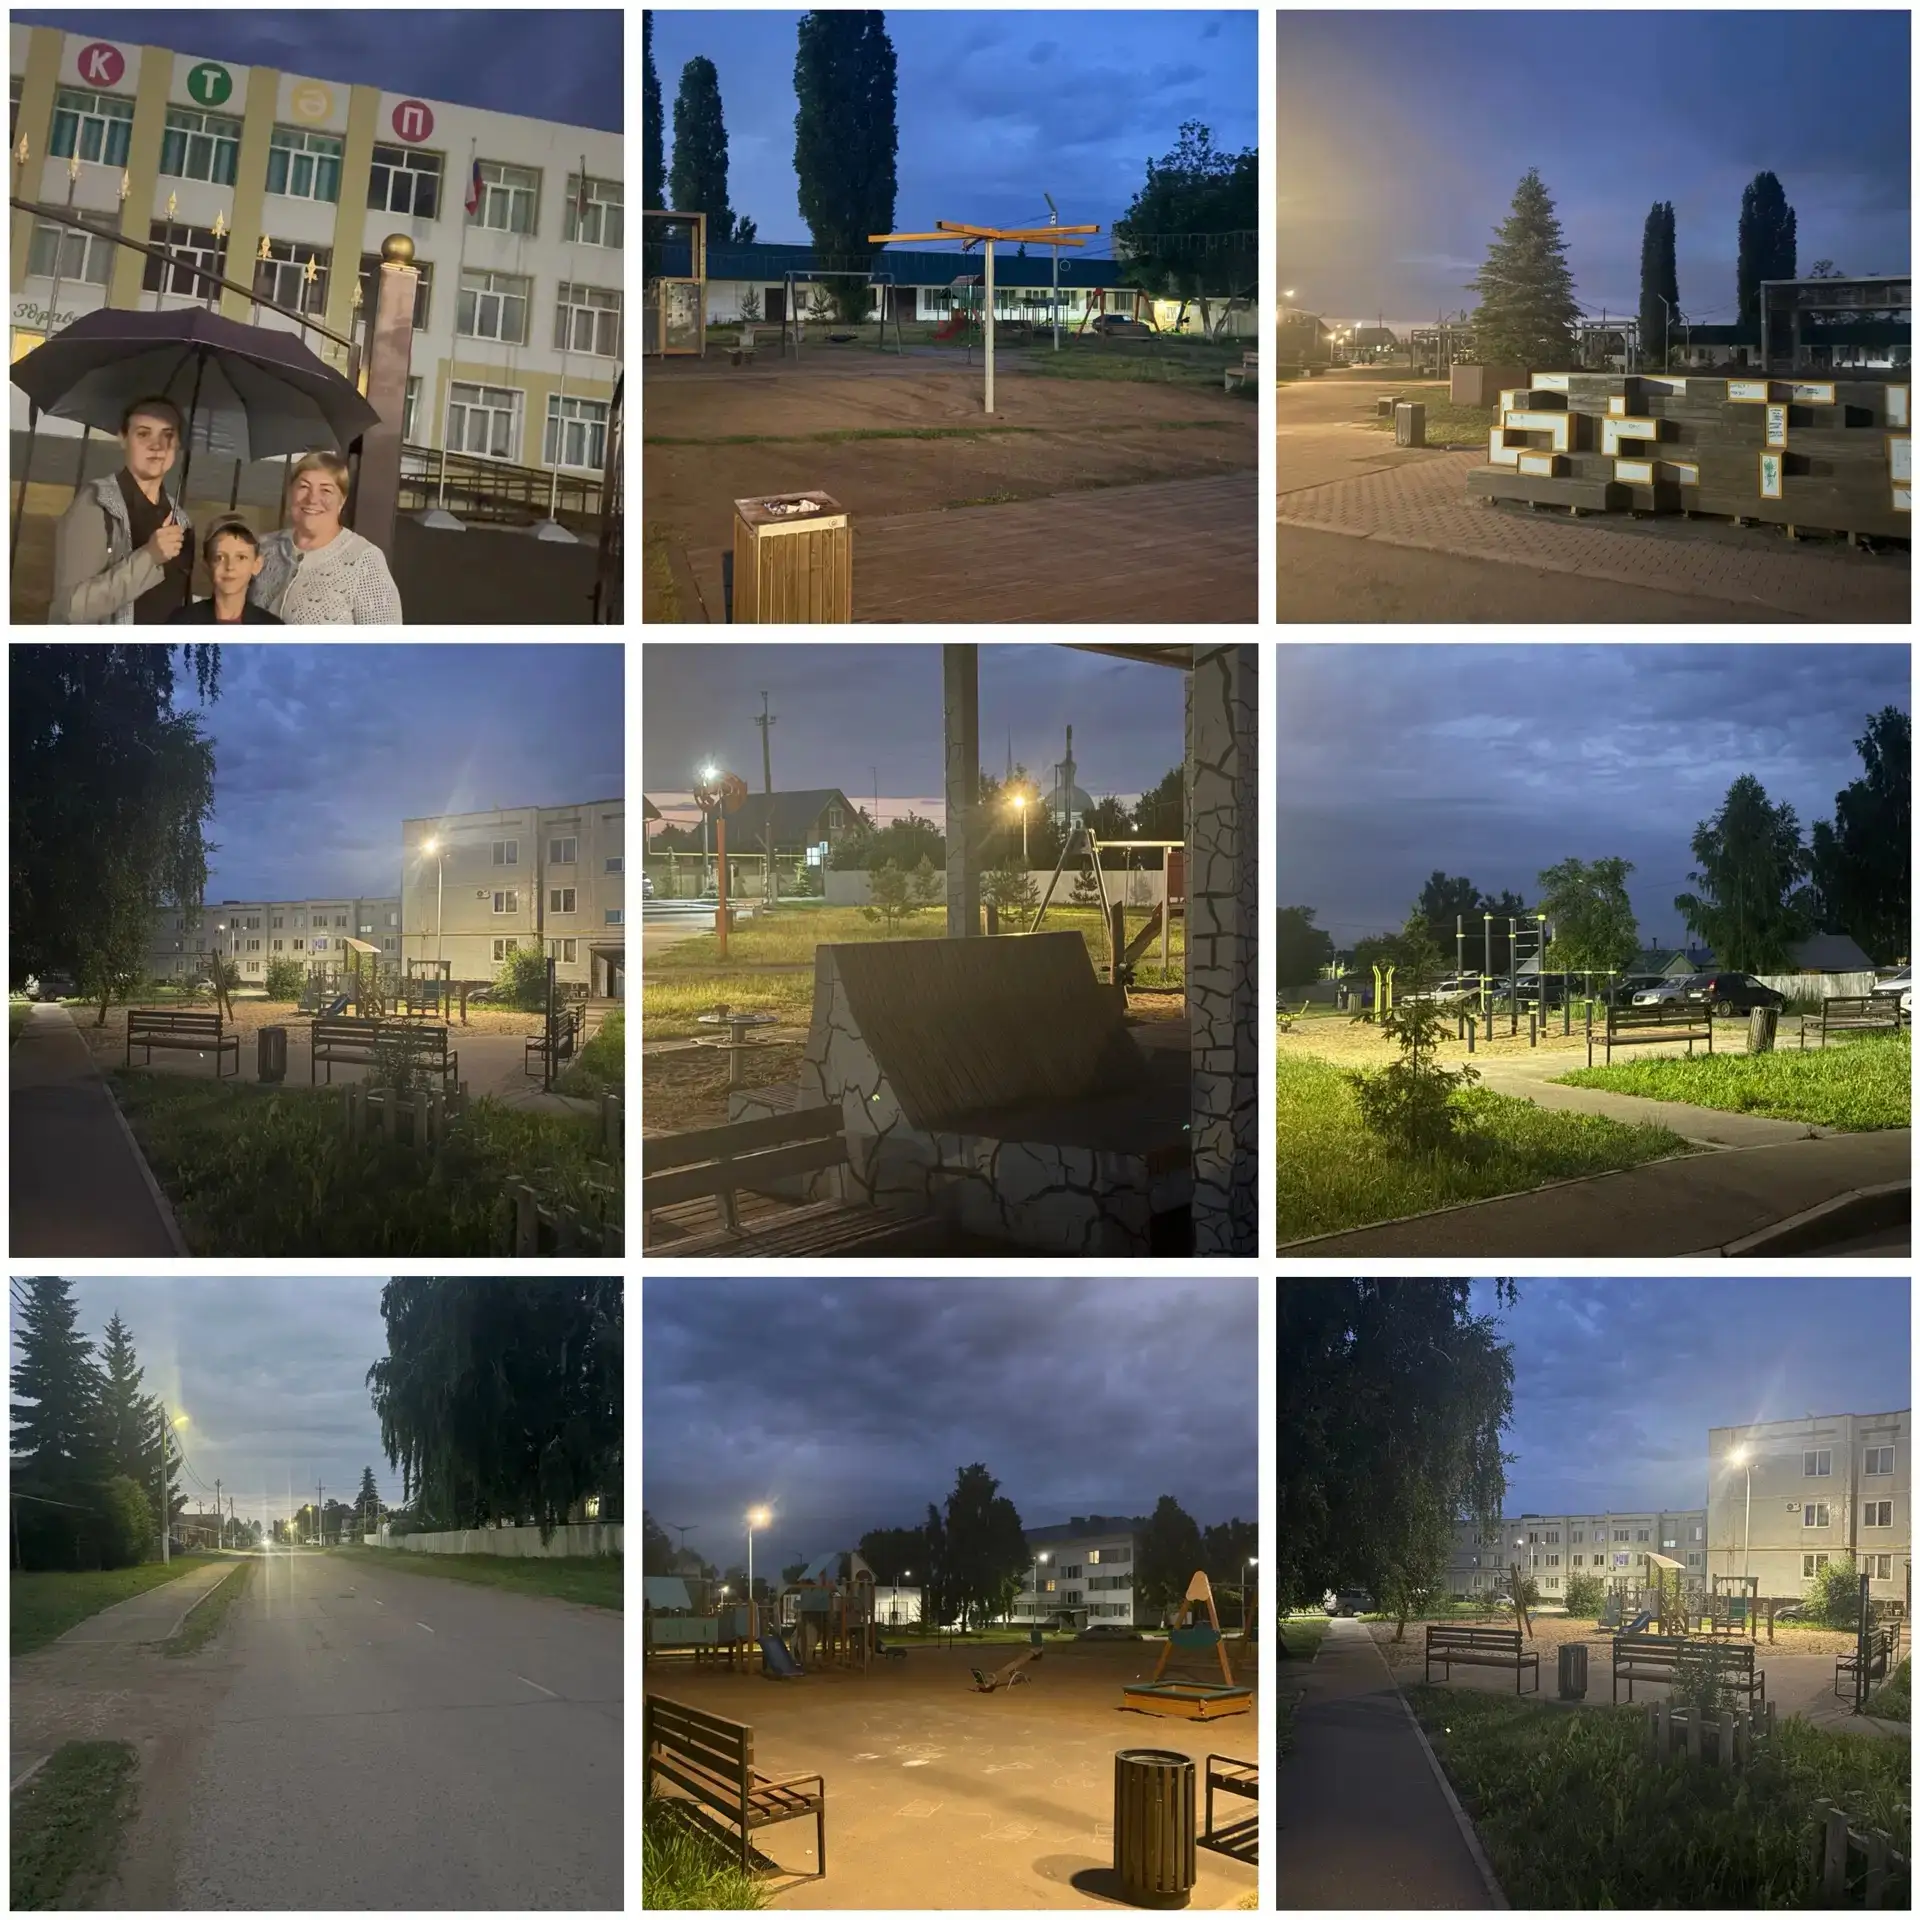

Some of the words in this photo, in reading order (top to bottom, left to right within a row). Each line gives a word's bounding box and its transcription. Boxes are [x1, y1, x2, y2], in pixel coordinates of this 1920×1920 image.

[89, 49, 113, 80] К
[201, 69, 221, 99] Т
[402, 106, 424, 136] П
